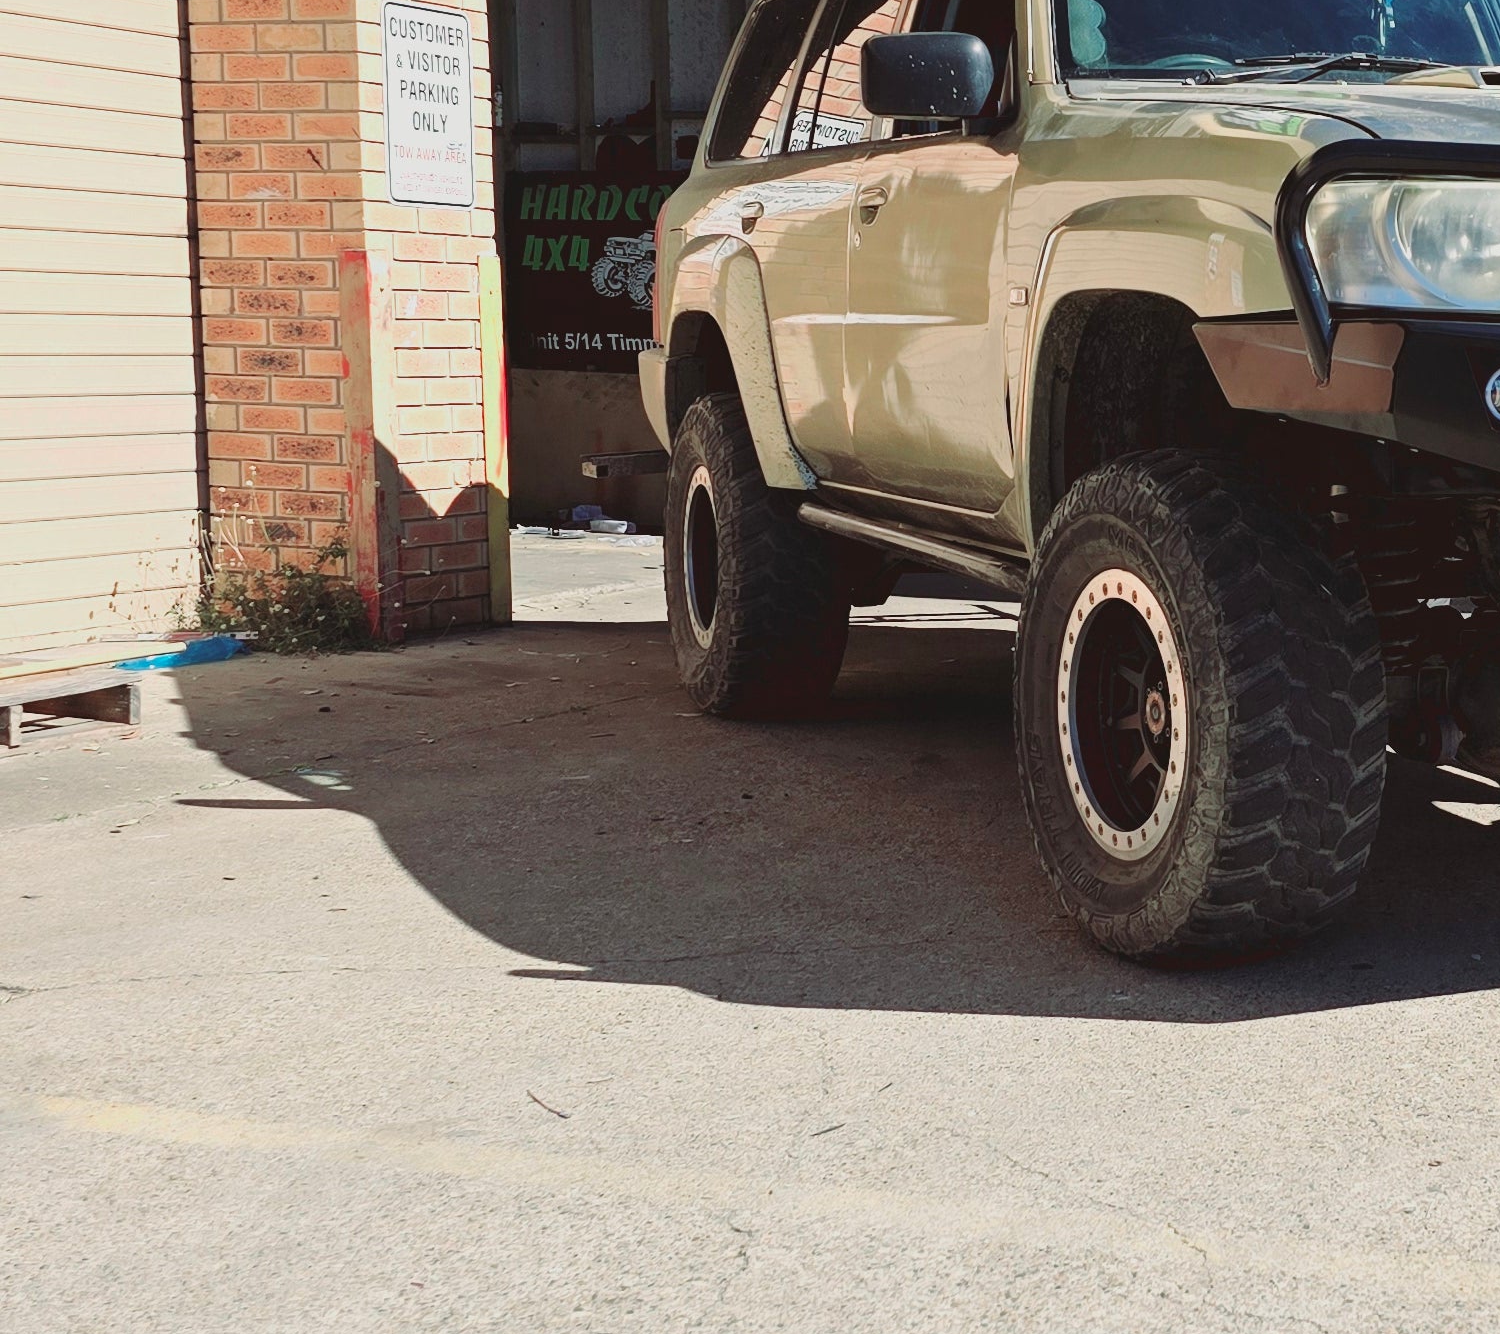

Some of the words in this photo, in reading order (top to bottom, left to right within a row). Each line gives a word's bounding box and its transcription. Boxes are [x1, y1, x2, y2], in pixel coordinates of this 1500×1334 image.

[389, 17, 464, 48] CUSTOMER
[396, 53, 403, 68] &
[407, 50, 461, 76] VISITOR
[399, 79, 459, 106] PARKING
[412, 110, 448, 134] ONLY
[394, 144, 413, 159] TOW
[416, 147, 441, 161] AWAY
[445, 150, 467, 164] AREA
[520, 183, 675, 221] HARDCO
[521, 234, 590, 272] 4X4
[565, 333, 603, 350] 5/14
